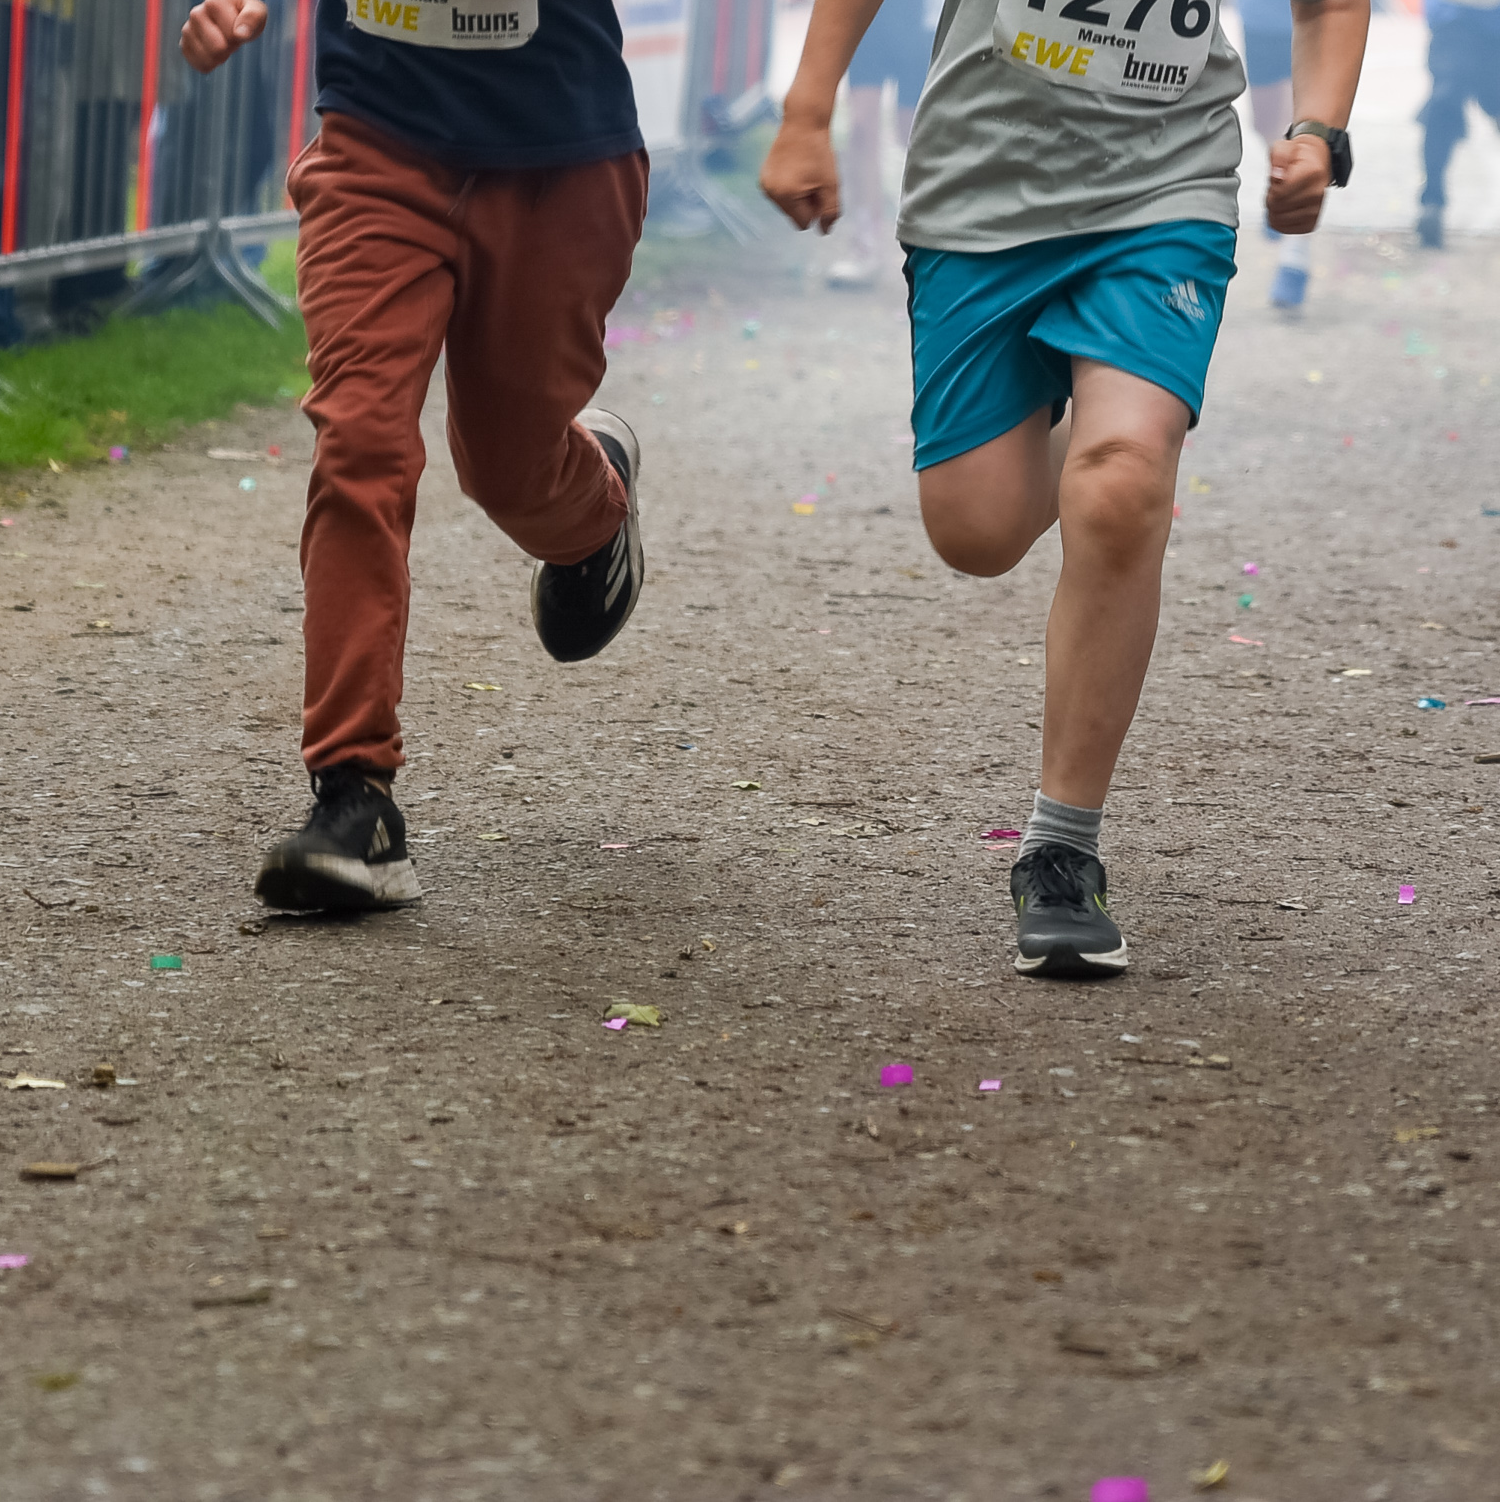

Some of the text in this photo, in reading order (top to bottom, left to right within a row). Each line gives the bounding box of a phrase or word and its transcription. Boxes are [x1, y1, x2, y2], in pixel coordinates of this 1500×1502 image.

[452, 7, 519, 32] bruns
[1077, 27, 1136, 50] Marten
[1010, 30, 1094, 77] EWE
[1123, 52, 1189, 86] bruns
